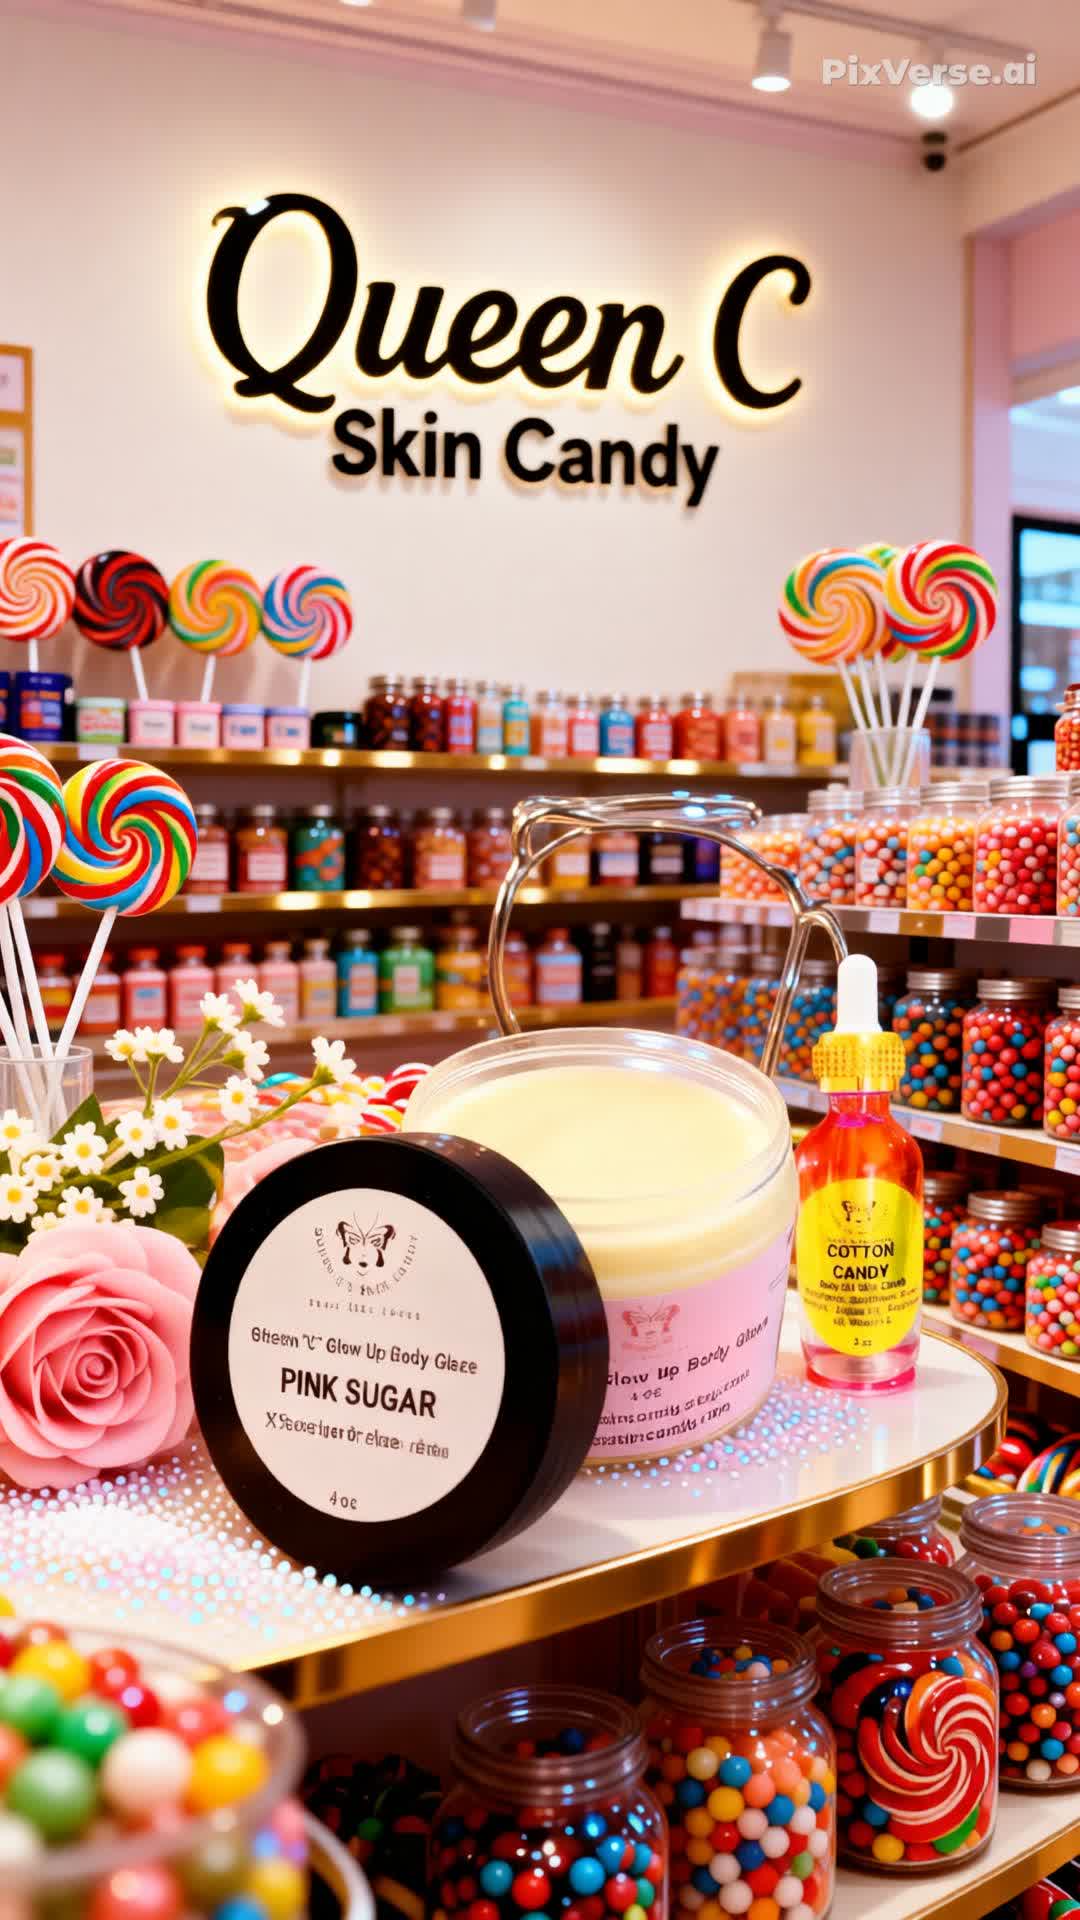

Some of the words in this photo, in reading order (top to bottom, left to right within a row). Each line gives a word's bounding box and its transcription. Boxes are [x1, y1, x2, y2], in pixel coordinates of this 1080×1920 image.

[207, 193, 684, 413] Queen
[713, 255, 811, 409] C
[332, 408, 481, 479] Skin
[504, 417, 719, 507] Candy
[827, 1241, 894, 1259] COTTON
[833, 1263, 889, 1280] CANDY
[366, 1342, 387, 1364] Up
[280, 1366, 339, 1403] PINK
[345, 1378, 437, 1419] SUGAR
